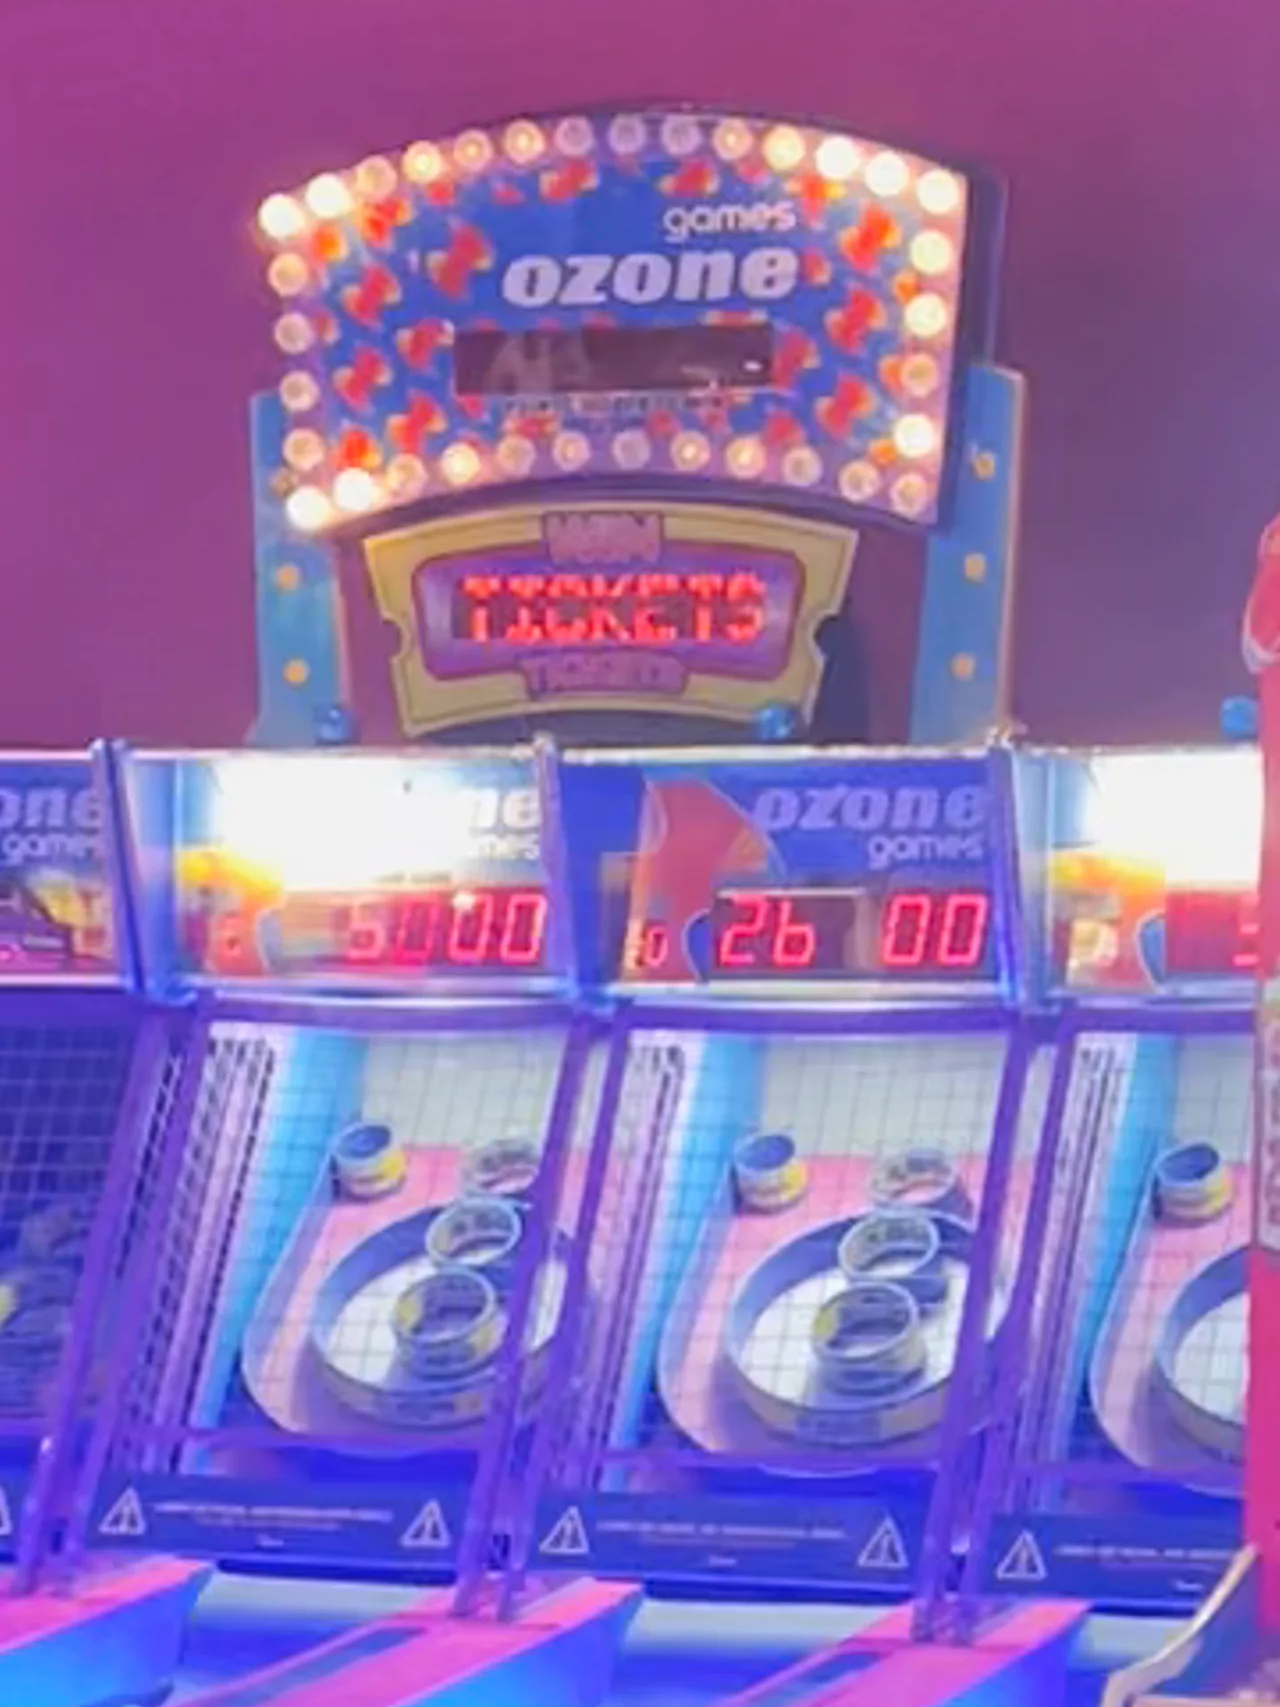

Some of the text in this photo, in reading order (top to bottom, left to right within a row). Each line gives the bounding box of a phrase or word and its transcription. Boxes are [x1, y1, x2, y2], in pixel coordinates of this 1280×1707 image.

[663, 201, 797, 243] games
[503, 247, 799, 308] ozone
[460, 572, 767, 643] TICKETS
[754, 786, 987, 831] ozone
[867, 835, 985, 871] games
